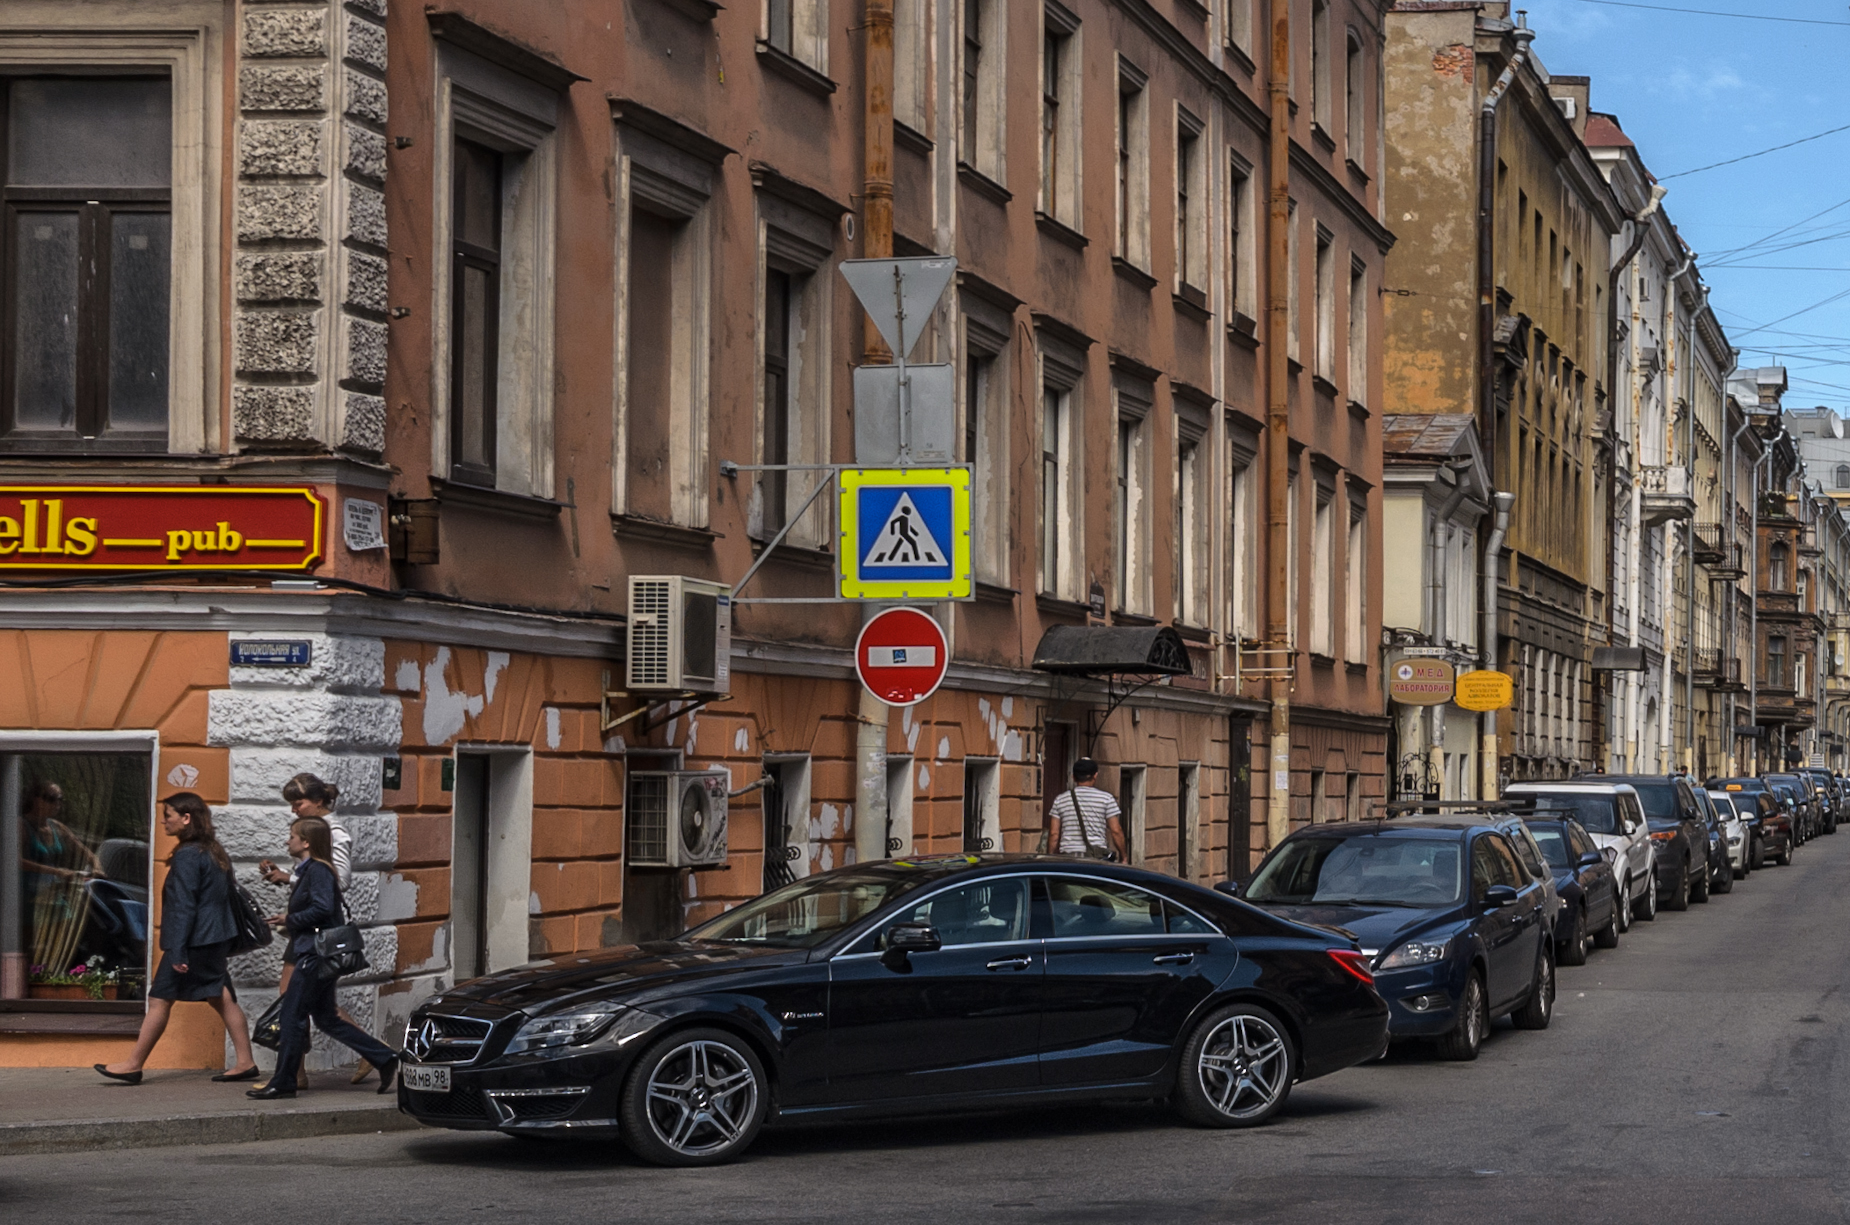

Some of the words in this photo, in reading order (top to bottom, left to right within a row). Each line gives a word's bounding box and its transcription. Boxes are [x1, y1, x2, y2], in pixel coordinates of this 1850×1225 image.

[166, 521, 243, 561] pub
[239, 643, 290, 656] КОЛОКОЛЬНАЯ
[1417, 668, 1444, 677] МЕД
[1394, 683, 1450, 692] ЛАБОРАТОРИЯ
[433, 1069, 446, 1083] 98
